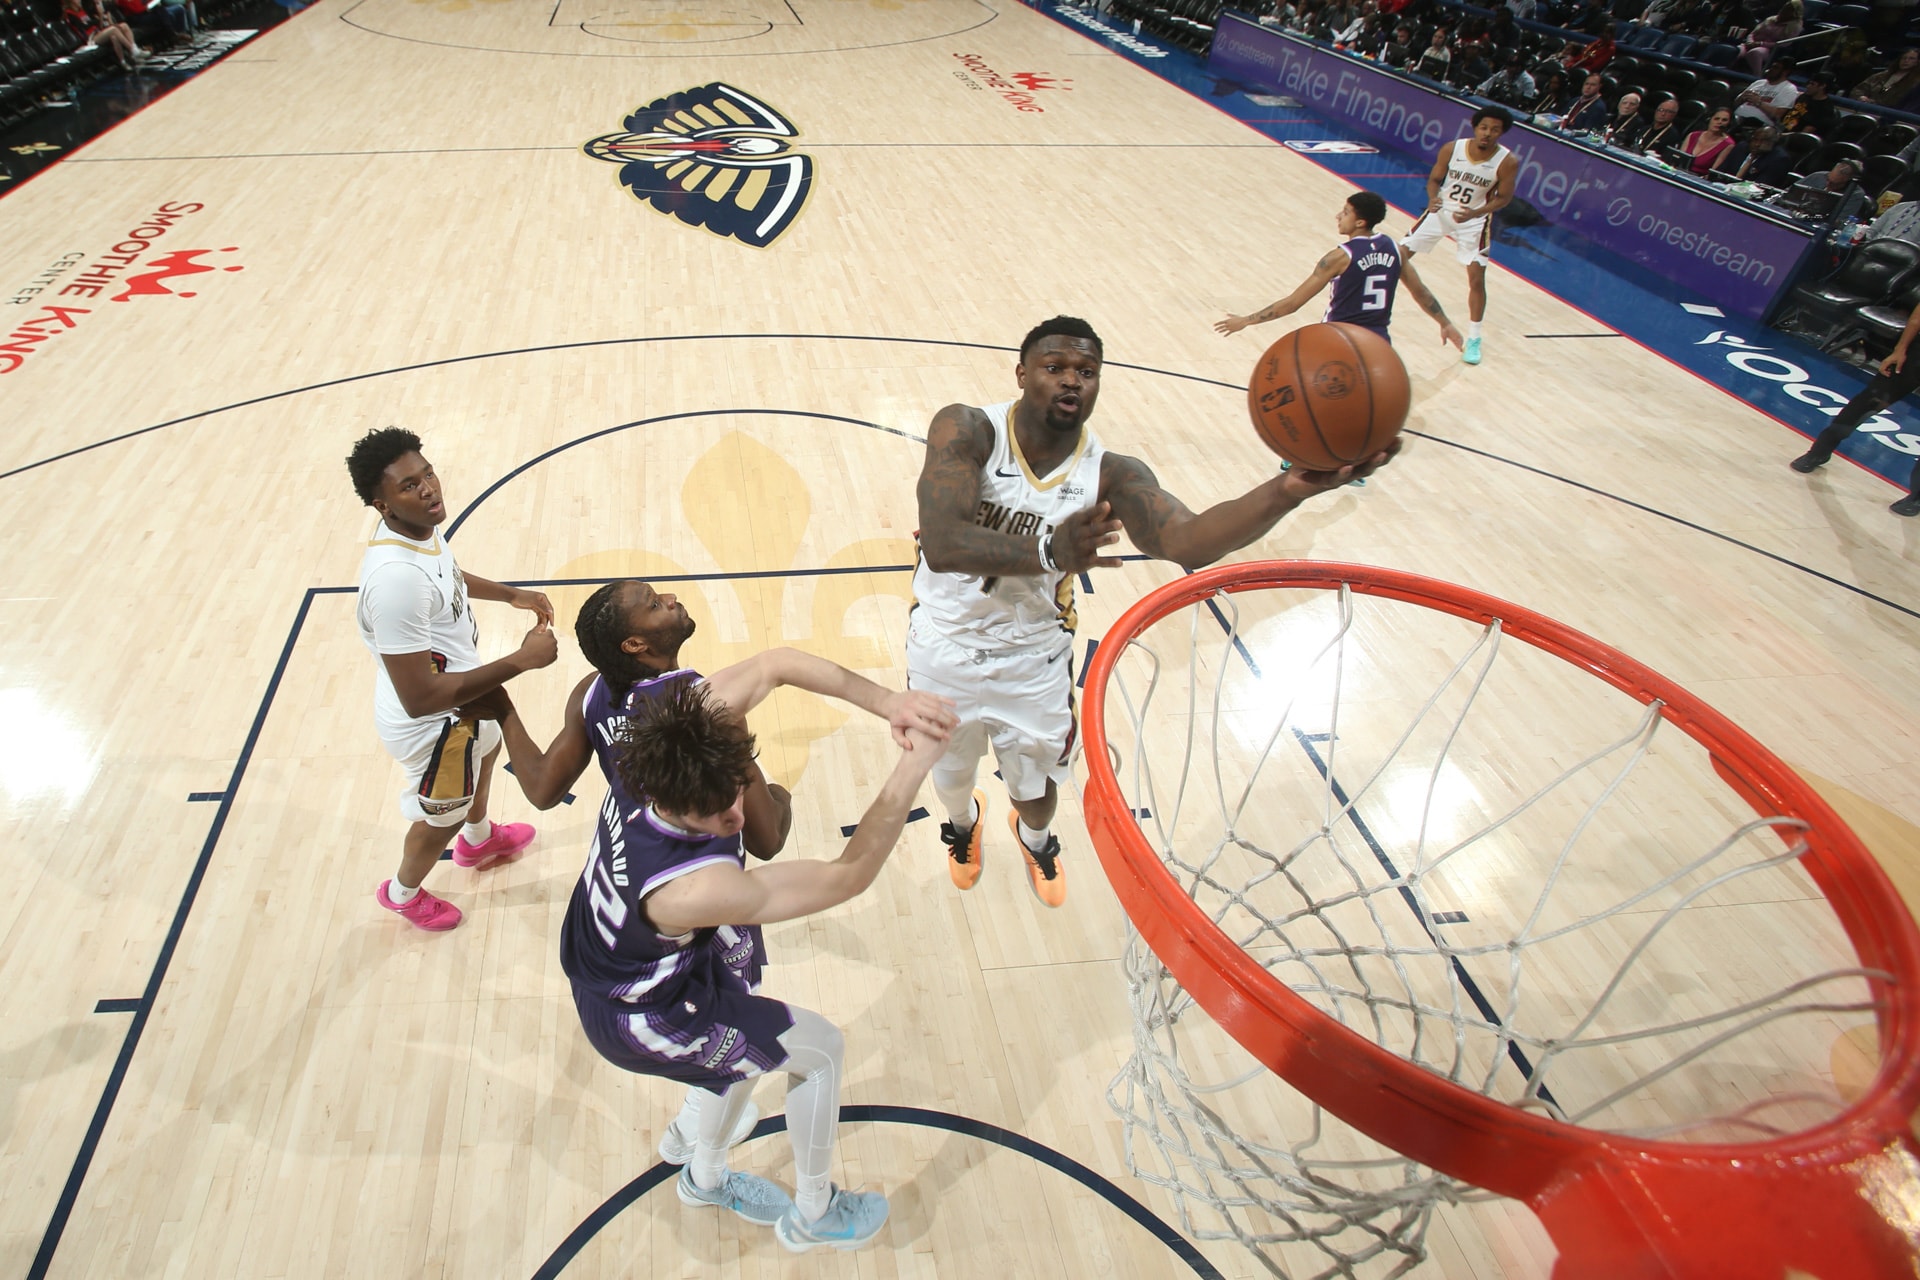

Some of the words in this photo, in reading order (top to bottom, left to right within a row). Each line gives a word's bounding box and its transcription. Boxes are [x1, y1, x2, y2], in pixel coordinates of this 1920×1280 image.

[1228, 35, 1275, 66] onestream
[953, 53, 1015, 89] SMOOTHIE
[953, 71, 983, 90] CENTER
[1278, 48, 1328, 100] Take
[1331, 71, 1442, 151] Finance
[1449, 184, 1474, 204] 25
[1462, 172, 1492, 187] ORLEANS
[58, 201, 204, 298] SMOOTHIE
[1357, 252, 1395, 271] CLIFFORD
[1638, 214, 1775, 286] onestream
[6, 252, 86, 304] CENTER
[1362, 274, 1387, 310] 5
[705, 1026, 739, 1068] KINGS
